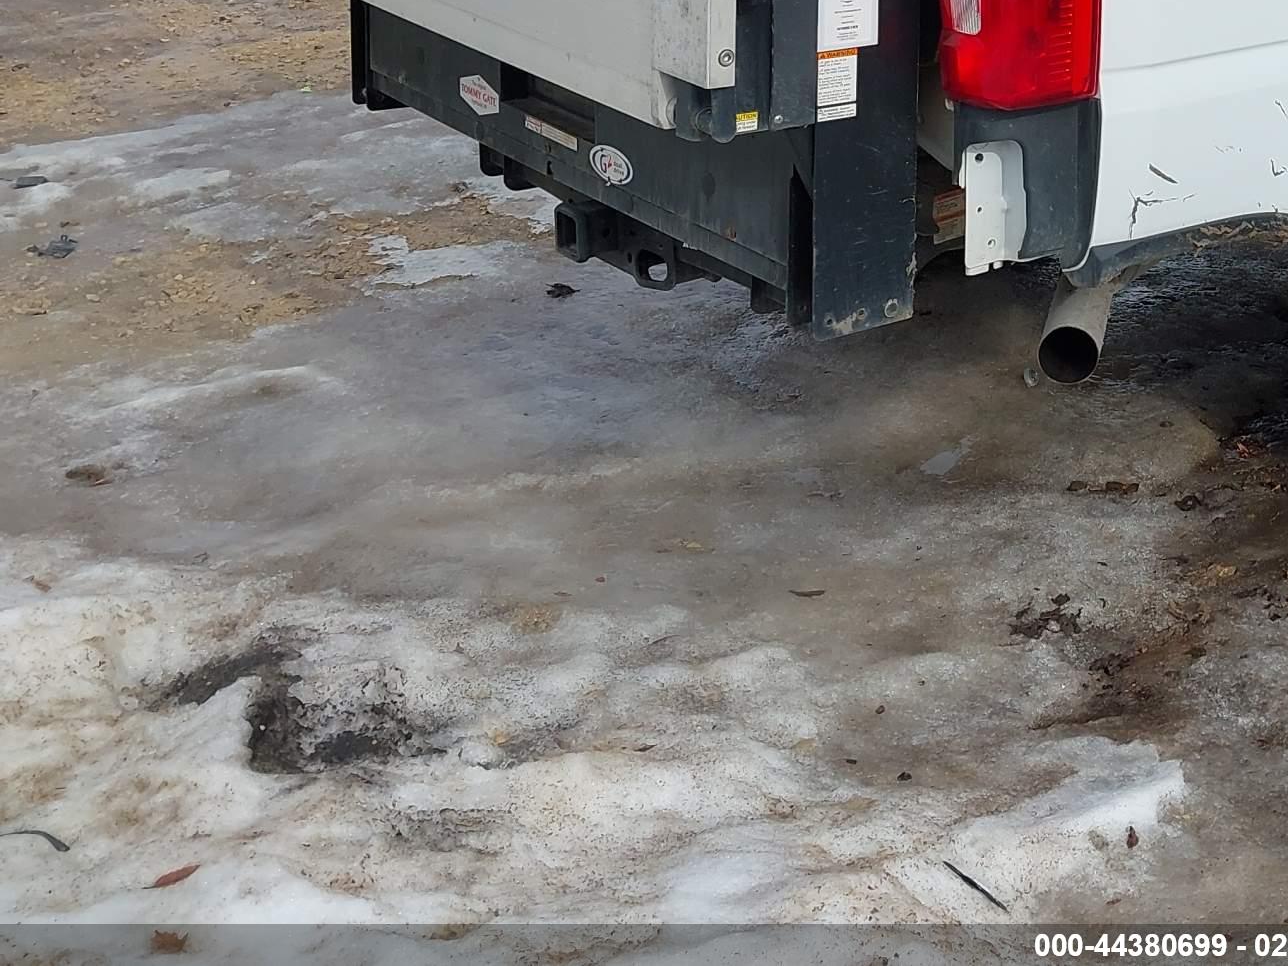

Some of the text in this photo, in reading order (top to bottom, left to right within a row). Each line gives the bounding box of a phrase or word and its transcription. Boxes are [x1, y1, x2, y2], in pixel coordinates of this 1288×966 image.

[827, 49, 856, 57] WARNING
[461, 83, 481, 100] TOMMY
[482, 93, 497, 106] GATE
